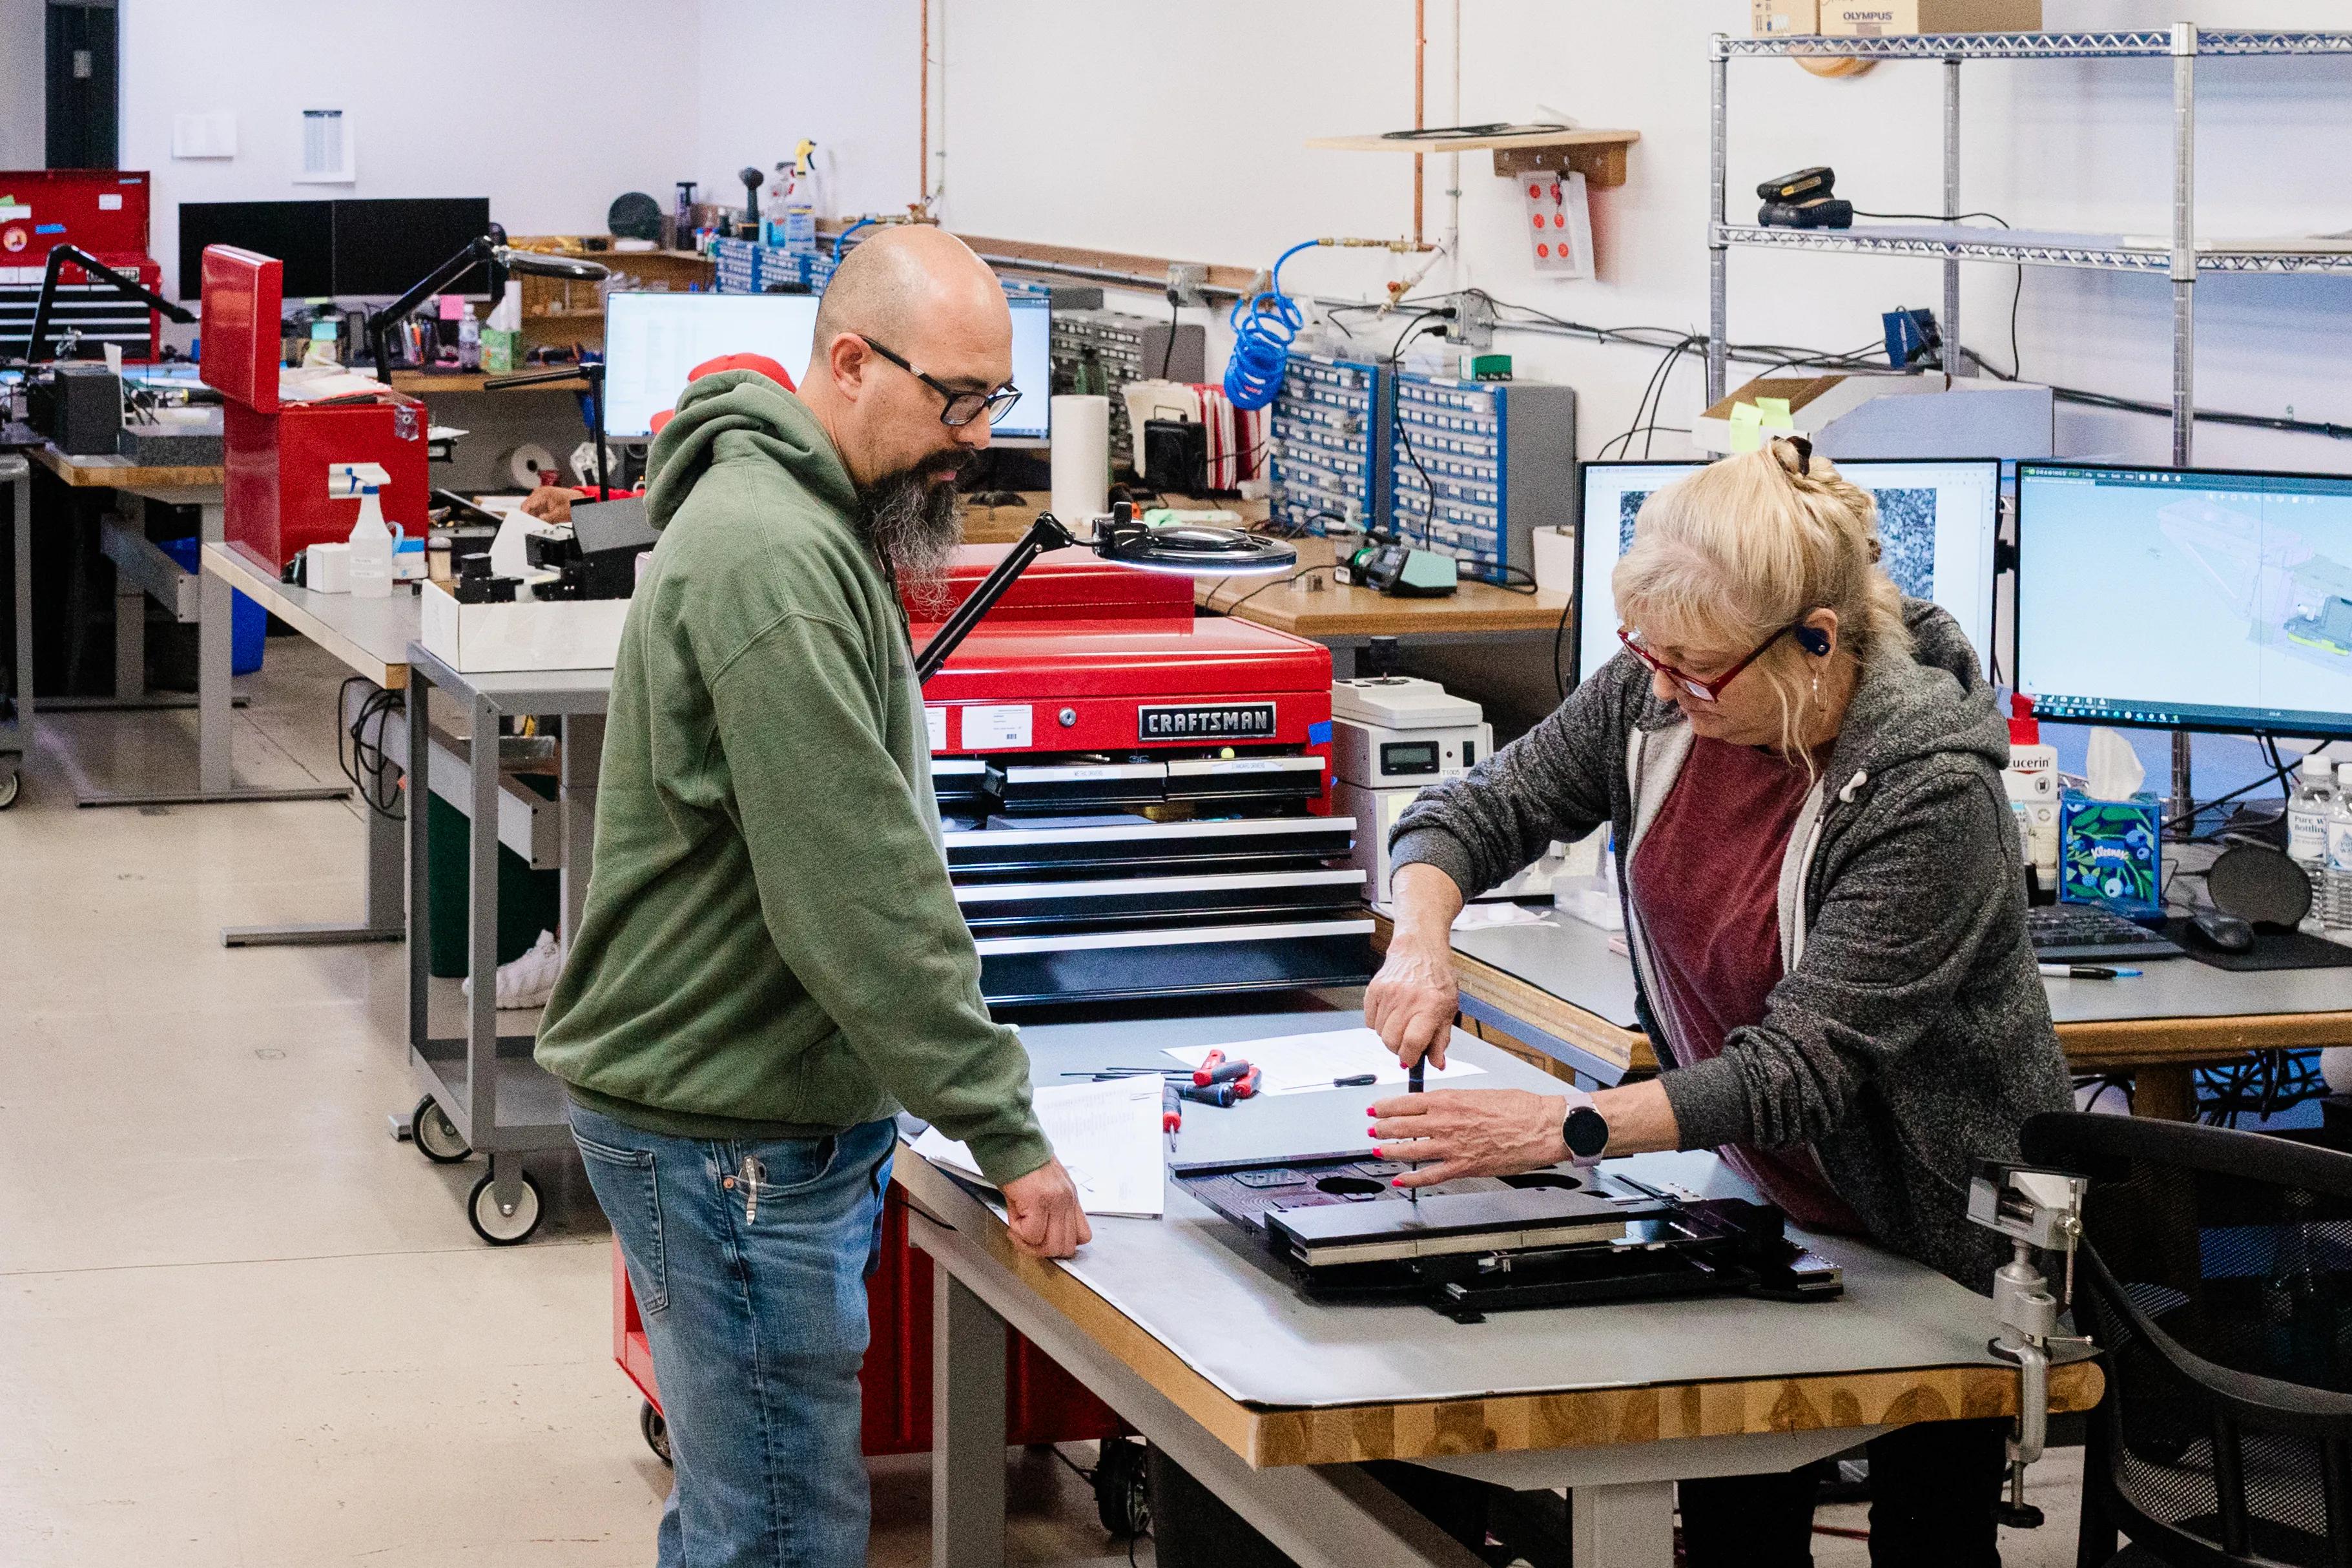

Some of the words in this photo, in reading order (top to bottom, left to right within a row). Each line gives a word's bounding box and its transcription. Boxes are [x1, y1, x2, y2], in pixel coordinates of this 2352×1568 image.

[1842, 11, 1893, 21] OLYMPUS
[1148, 711, 1267, 732] CRAFTSMAN
[2010, 757, 2049, 768] ucerin
[2090, 845, 2129, 860] Kleenex
